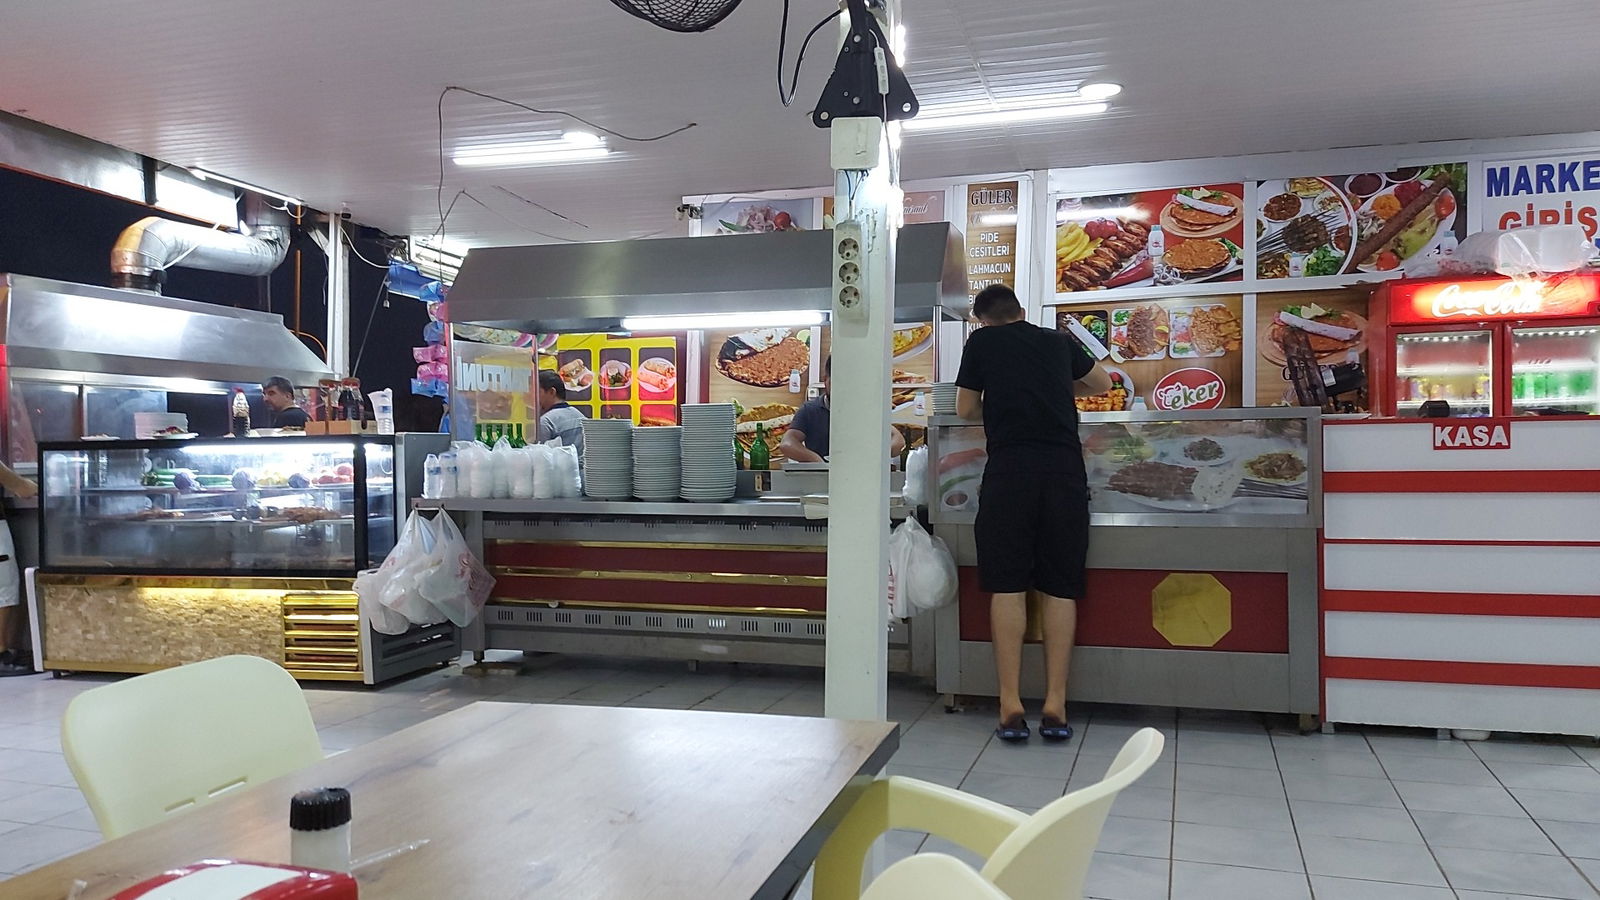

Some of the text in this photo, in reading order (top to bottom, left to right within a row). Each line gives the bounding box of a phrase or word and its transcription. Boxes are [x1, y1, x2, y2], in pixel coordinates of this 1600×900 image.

[1487, 160, 1600, 197] MARKE
[971, 186, 1013, 207] GÜLER
[968, 263, 1011, 275] LAHMACUN
[1171, 383, 1219, 410] eker
[1435, 425, 1509, 447] KASA
